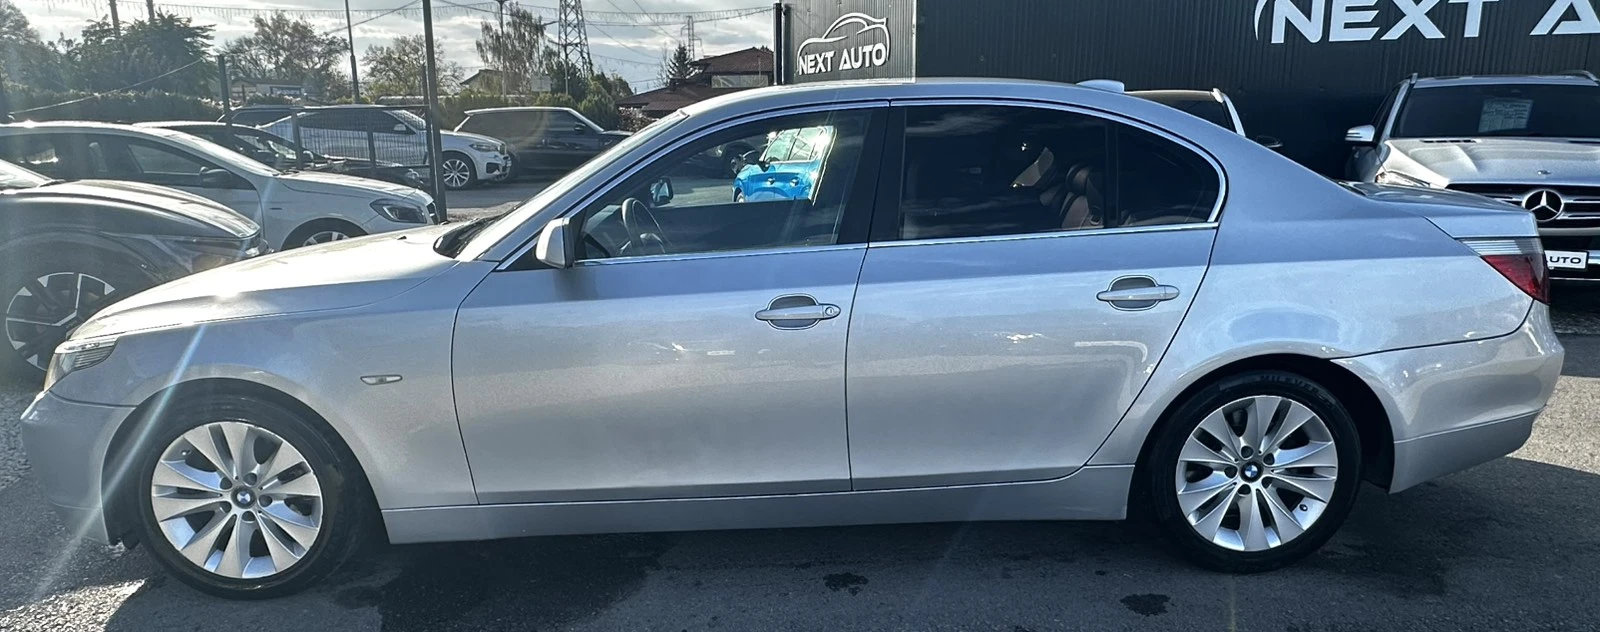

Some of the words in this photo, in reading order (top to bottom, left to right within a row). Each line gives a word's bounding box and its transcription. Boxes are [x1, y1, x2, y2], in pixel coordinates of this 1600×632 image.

[1271, 0, 1500, 44] NEXT
[798, 51, 836, 75] NEXT
[838, 43, 887, 71] AUTO
